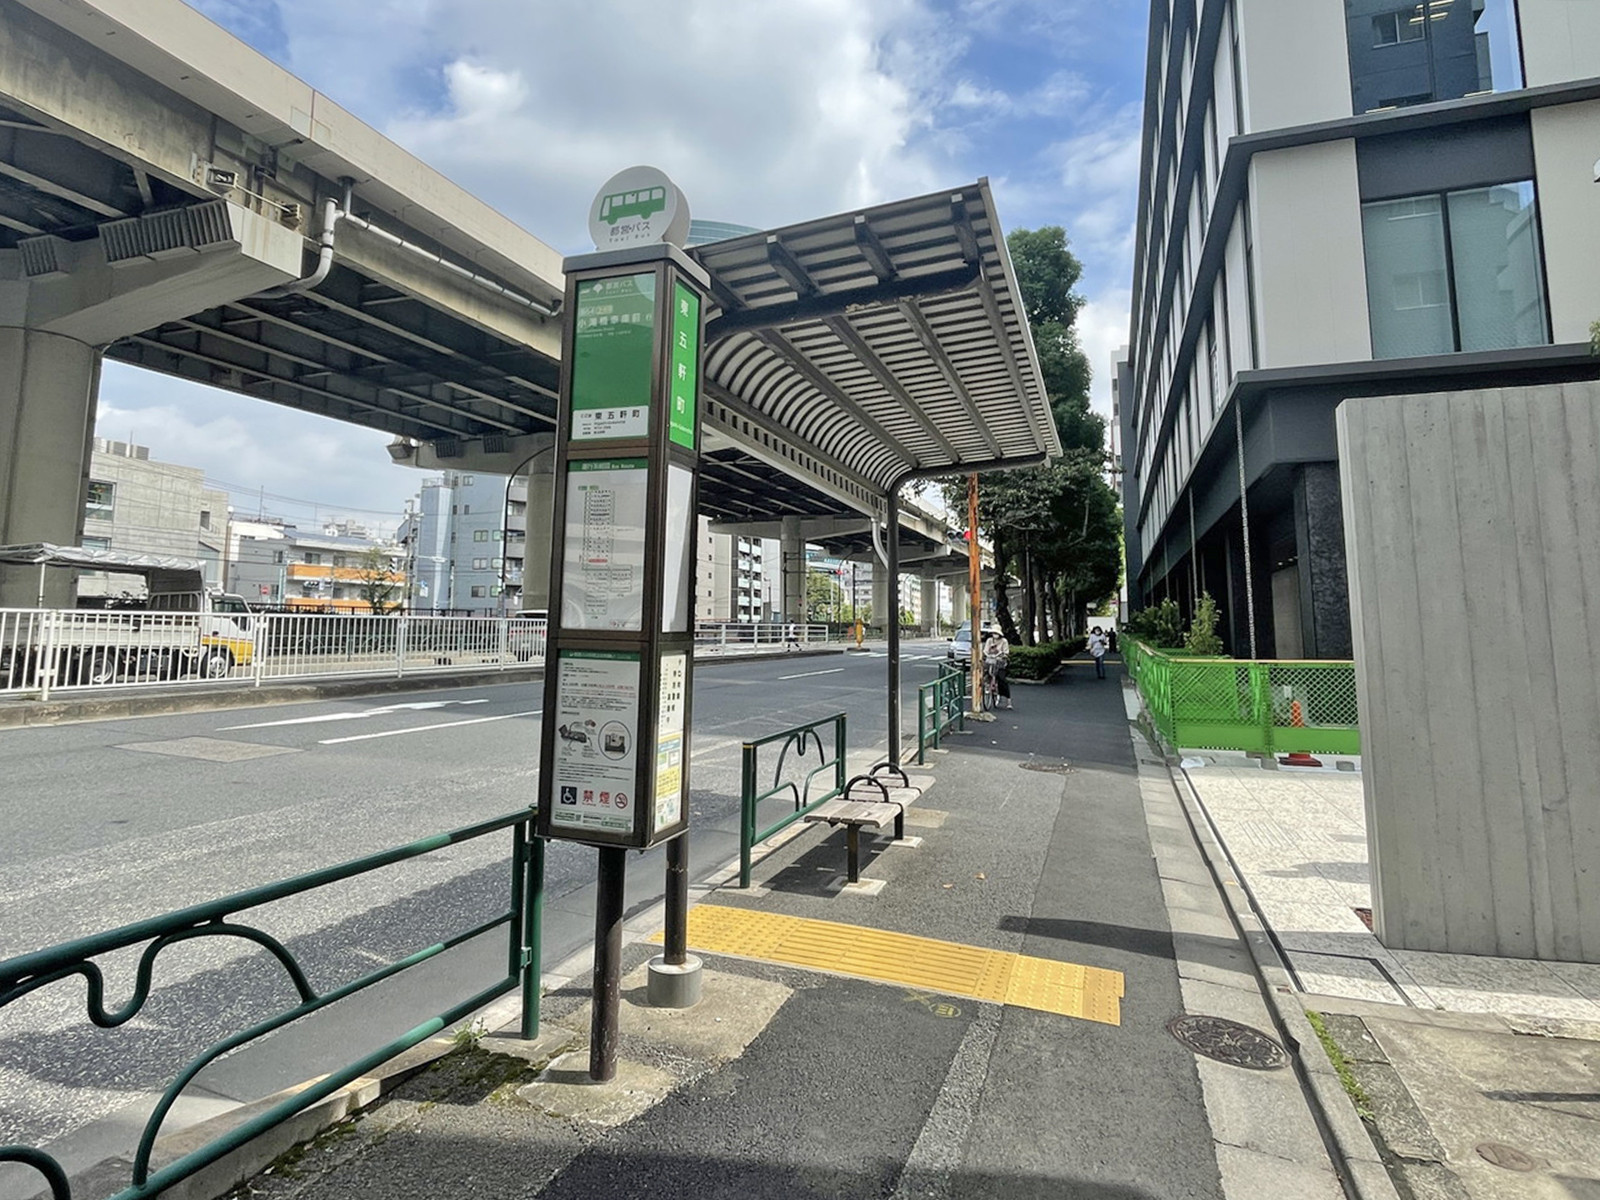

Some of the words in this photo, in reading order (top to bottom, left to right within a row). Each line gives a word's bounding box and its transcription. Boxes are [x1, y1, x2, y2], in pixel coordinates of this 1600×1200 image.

[610, 221, 651, 236] 都営バス
[676, 298, 689, 415] 東五軒町
[595, 409, 640, 420] 東五軒町
[582, 789, 611, 805] 禁煙
